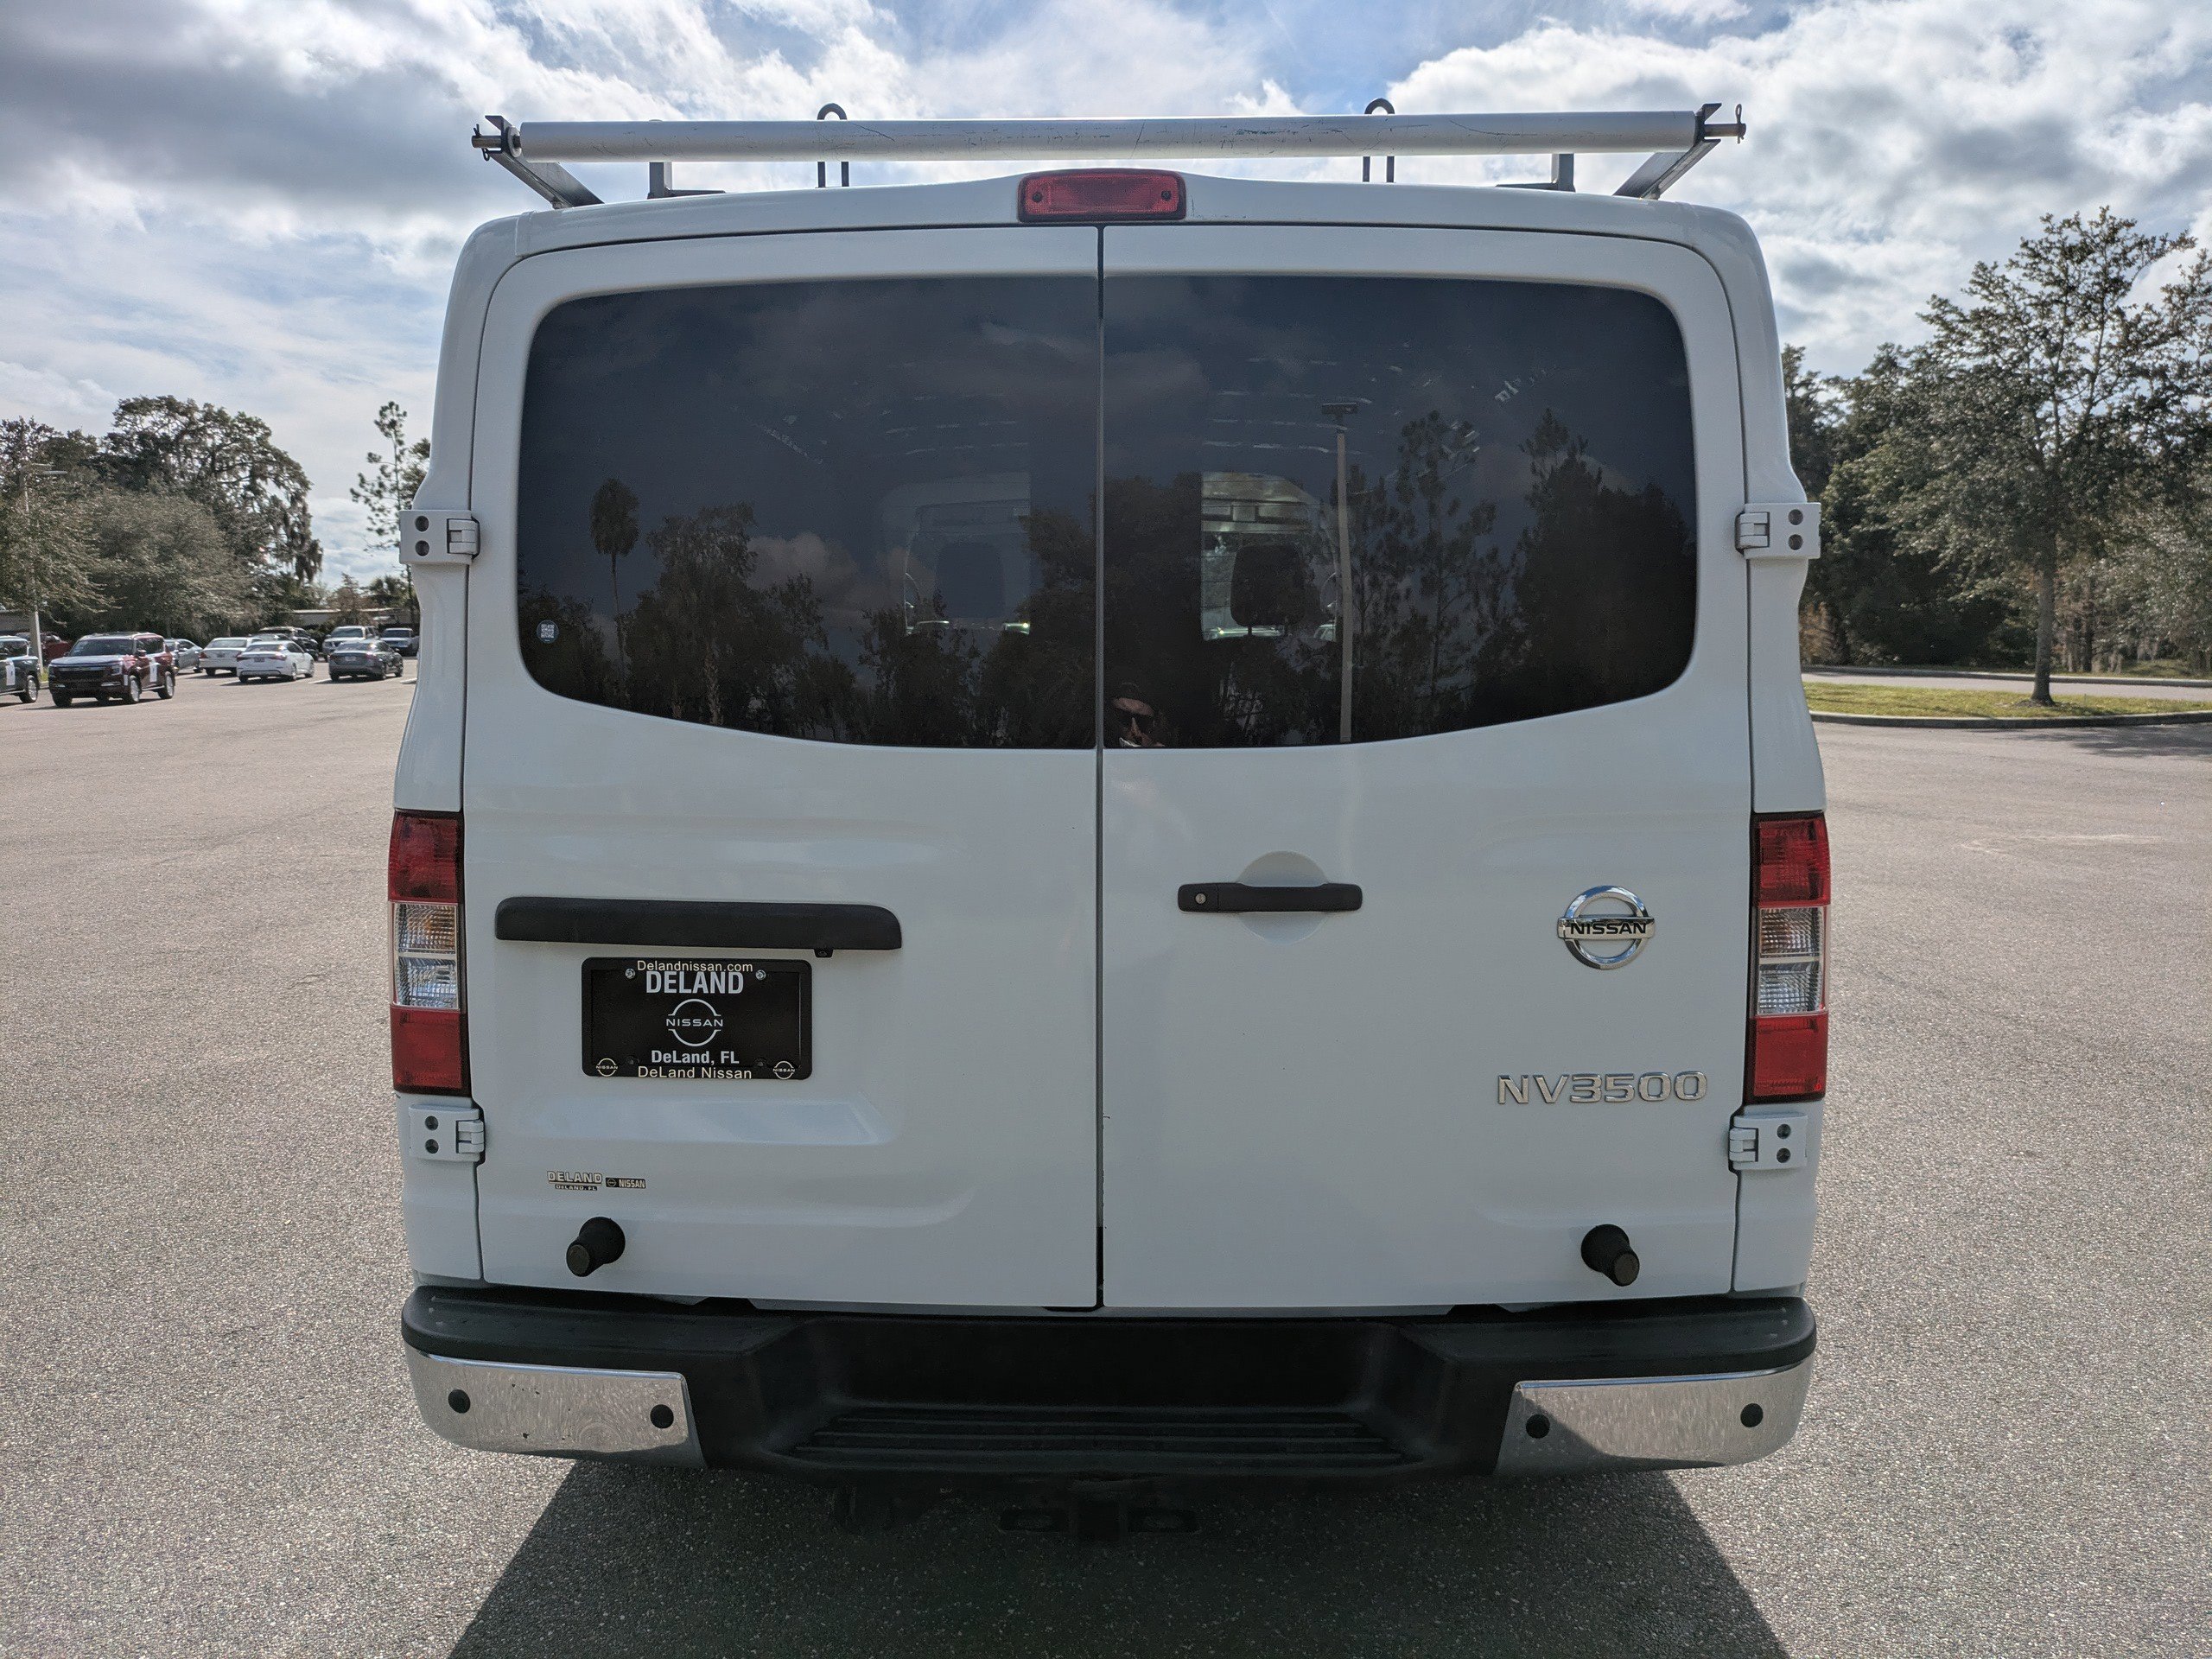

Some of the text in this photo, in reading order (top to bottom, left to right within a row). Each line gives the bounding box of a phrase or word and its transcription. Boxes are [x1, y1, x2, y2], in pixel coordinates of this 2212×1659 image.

[1570, 923, 1646, 935] NISSAN
[637, 960, 753, 972] Delandnissan.com
[646, 971, 743, 994] DELAND
[652, 1050, 739, 1065] DeLand, FL
[639, 1066, 752, 1079] DeLand Nissan
[1497, 1071, 1707, 1104] NV3500
[547, 1171, 602, 1184] DELAND
[619, 1179, 645, 1188] NISSAN
